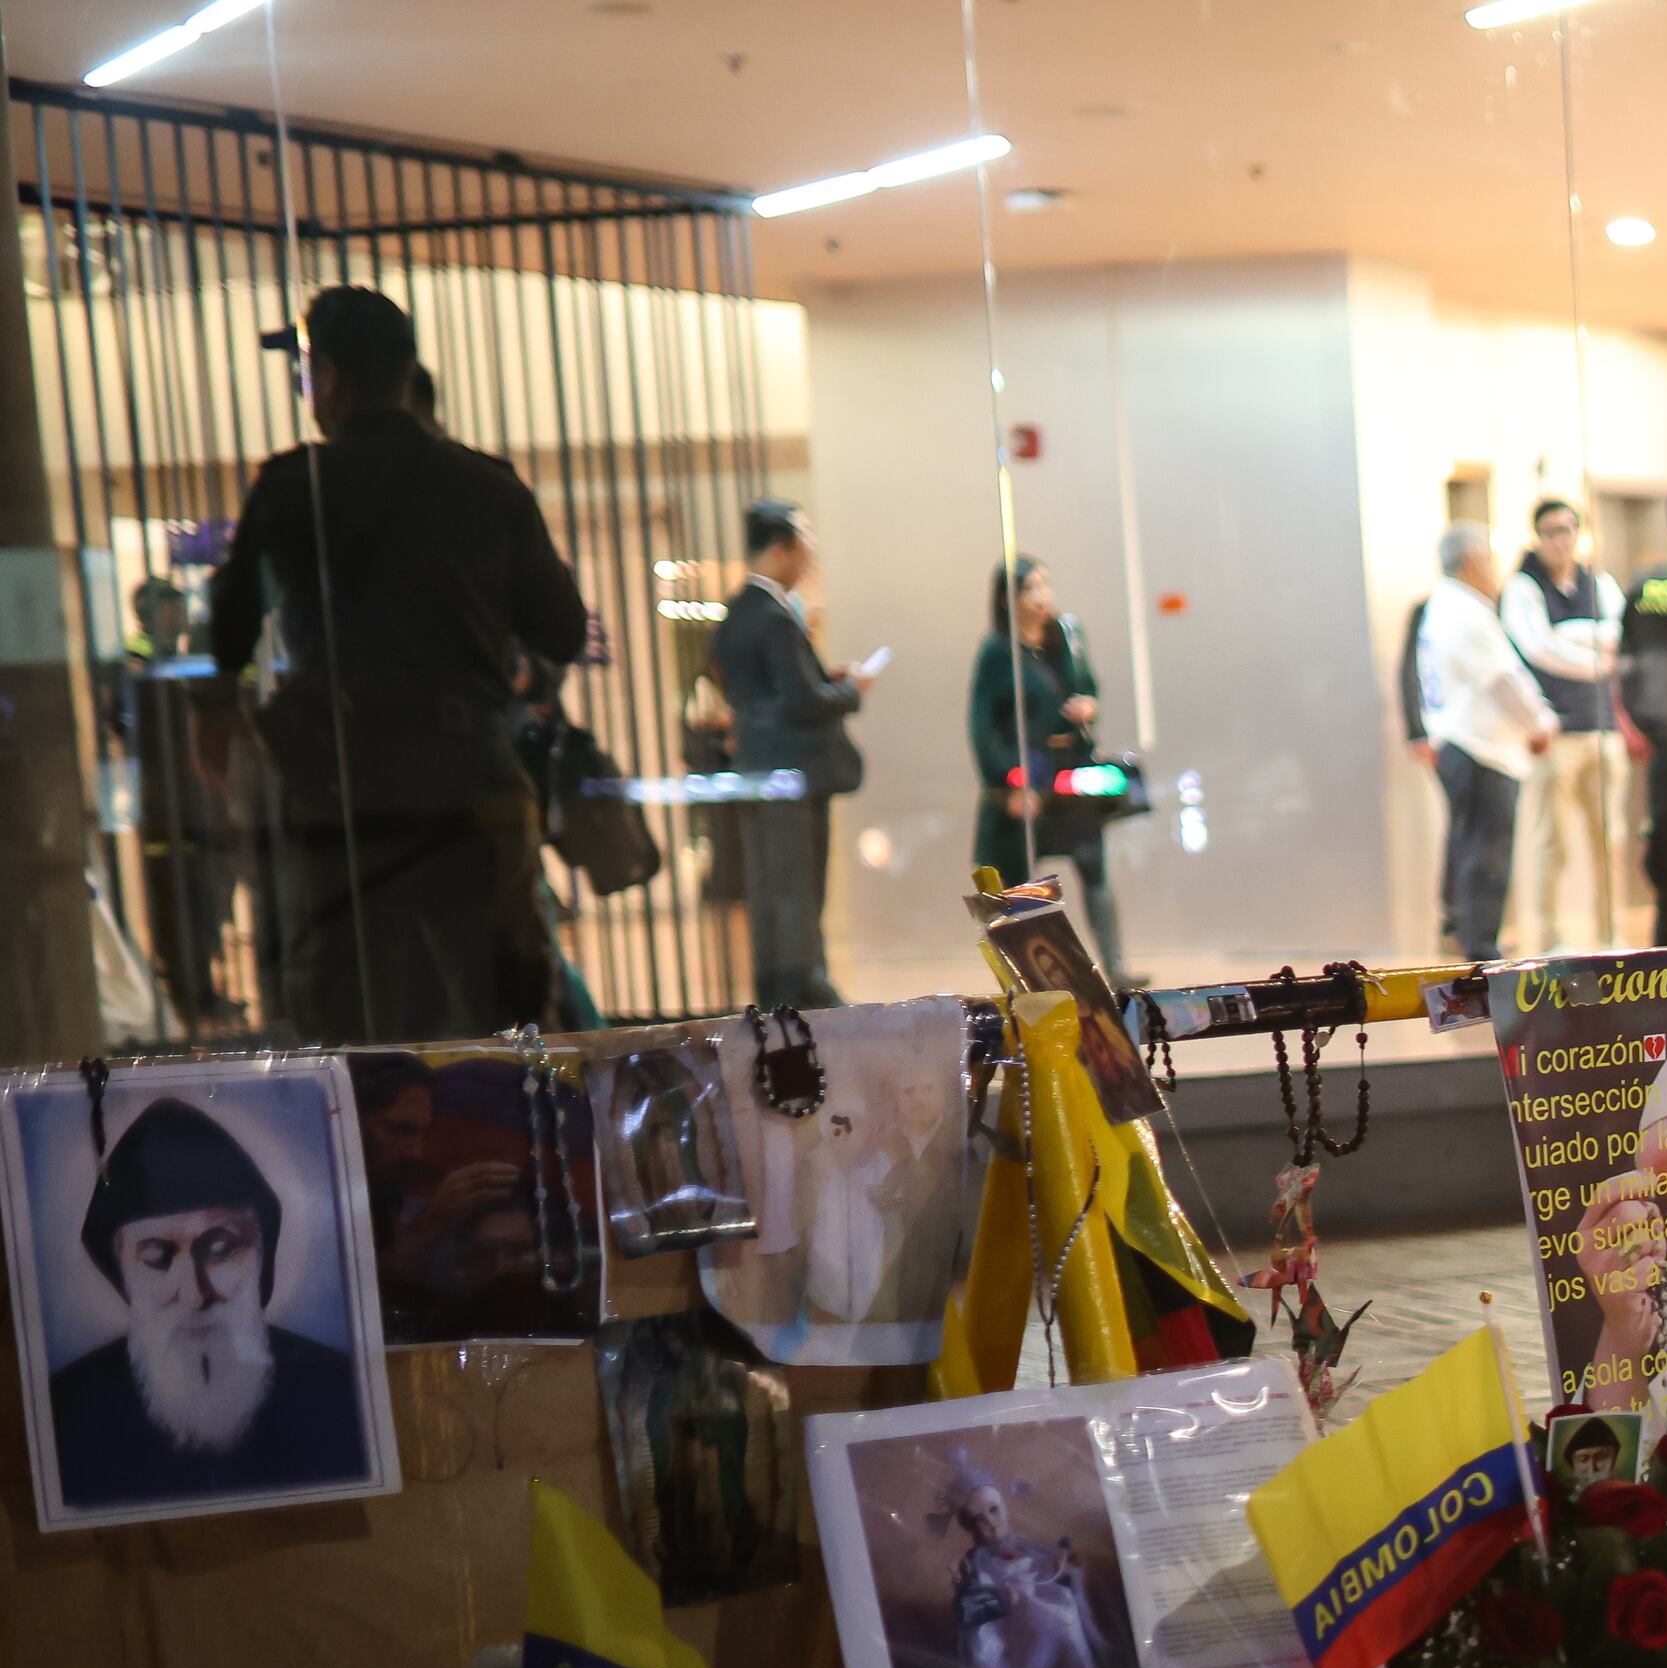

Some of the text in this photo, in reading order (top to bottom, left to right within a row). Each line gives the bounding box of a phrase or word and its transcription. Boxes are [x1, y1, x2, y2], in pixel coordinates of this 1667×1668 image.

[1537, 1036, 1645, 1075] corazón
[1607, 1128, 1647, 1164] por
[1580, 1180, 1612, 1207] un
[1594, 1270, 1637, 1299] vas
[1645, 1263, 1660, 1288] a
[1585, 1353, 1633, 1388] sola
